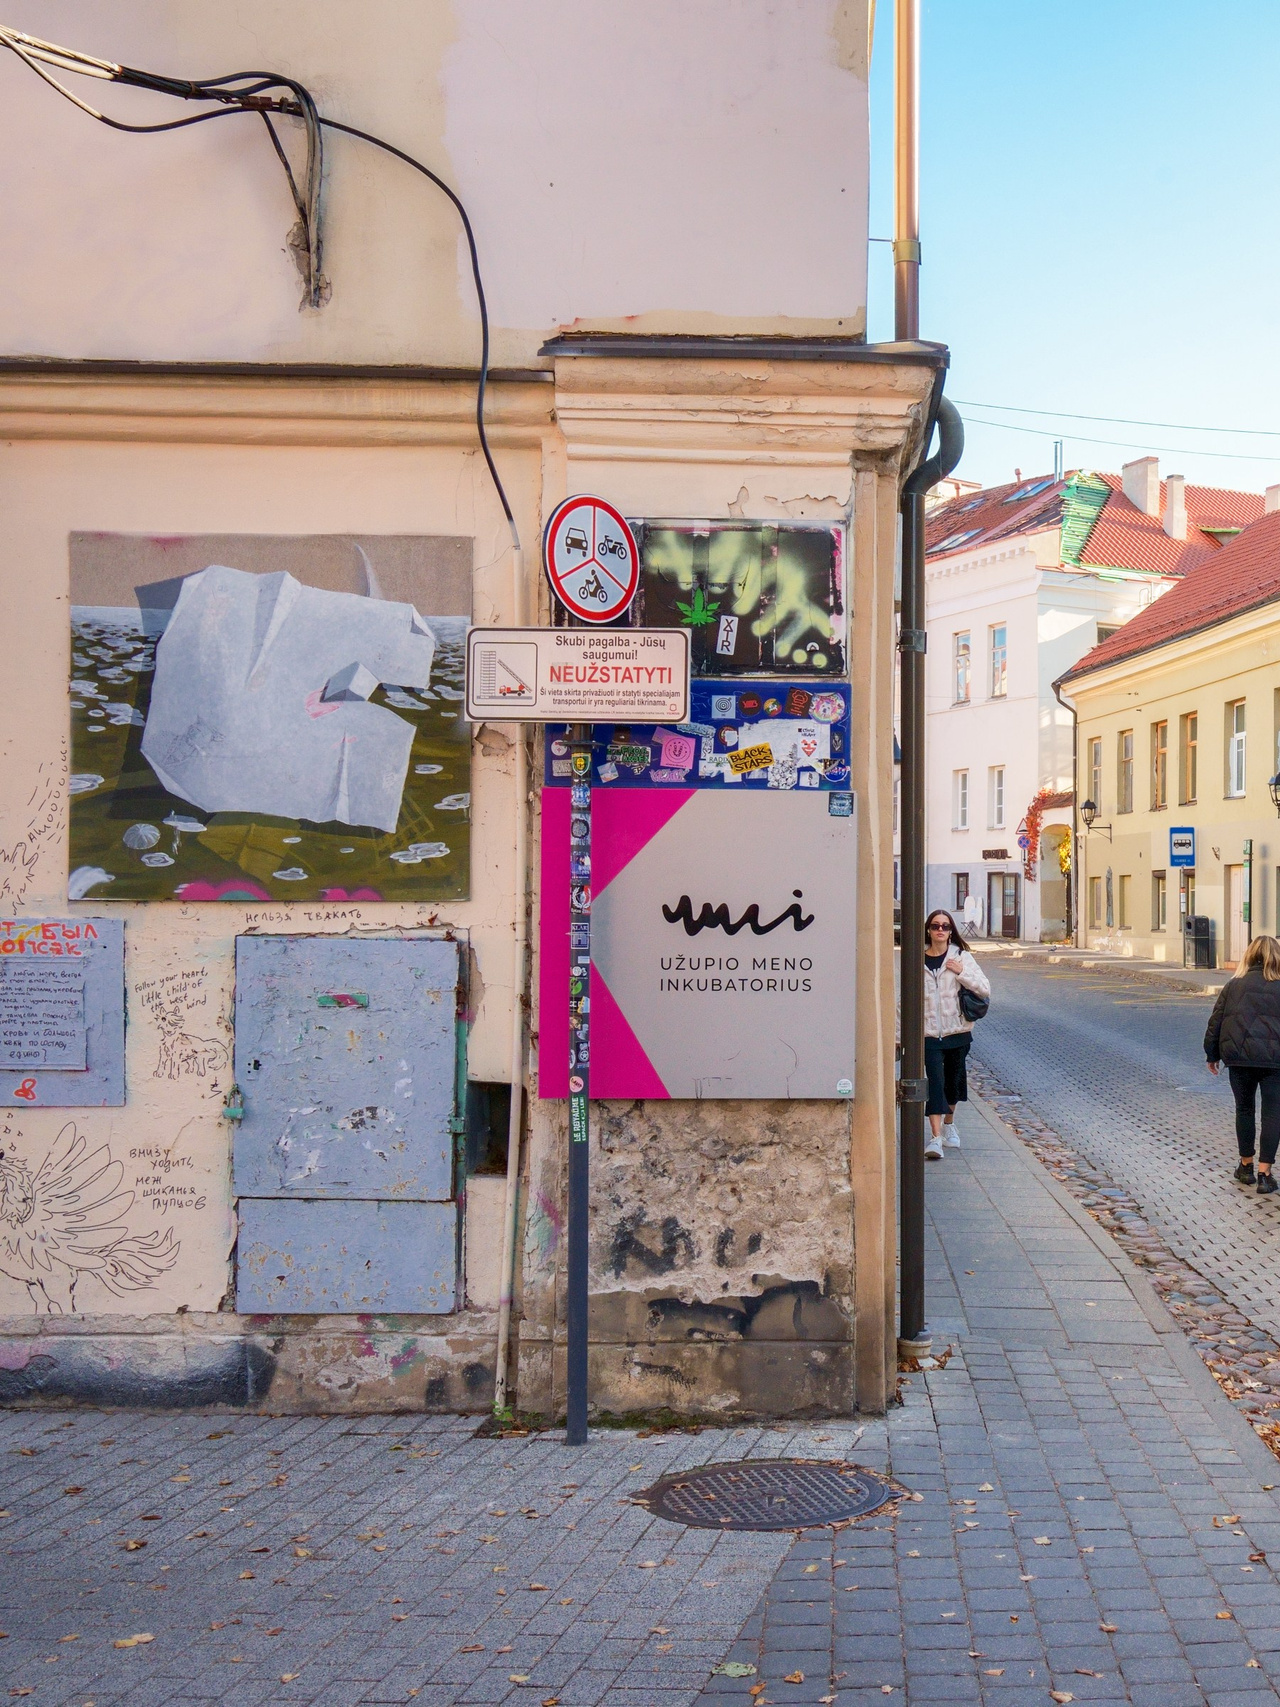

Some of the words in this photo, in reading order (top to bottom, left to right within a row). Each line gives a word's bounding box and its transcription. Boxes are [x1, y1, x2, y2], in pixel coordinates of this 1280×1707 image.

[556, 635, 586, 647] Skubi
[588, 637, 631, 650] pagalba
[640, 636, 666, 650] Jūsų
[582, 650, 638, 662] saugumui!
[549, 662, 673, 684] NEUŽSTATYTI
[540, 688, 547, 697] Ši
[548, 688, 563, 697] vieta
[563, 688, 582, 697] skirta
[582, 688, 615, 698] privažiuoti
[615, 689, 621, 697] ir
[621, 689, 642, 699] statyti
[642, 689, 681, 699] specialiajam
[552, 698, 588, 707] transportui
[588, 698, 593, 706] ir
[593, 699, 604, 708] yra
[605, 698, 636, 708] reguliariai
[636, 698, 668, 707] tikrinama.
[730, 747, 768, 763] BLACK
[735, 755, 773, 772] STARS
[41, 922, 98, 940] БЫЛ
[660, 954, 739, 971] UŽUPIO
[752, 957, 813, 971] MENO
[160, 974, 178, 988] your
[192, 979, 203, 989] of
[660, 978, 812, 992] INKUBATORIUS
[169, 994, 188, 1005] west
[187, 995, 207, 1010] wind
